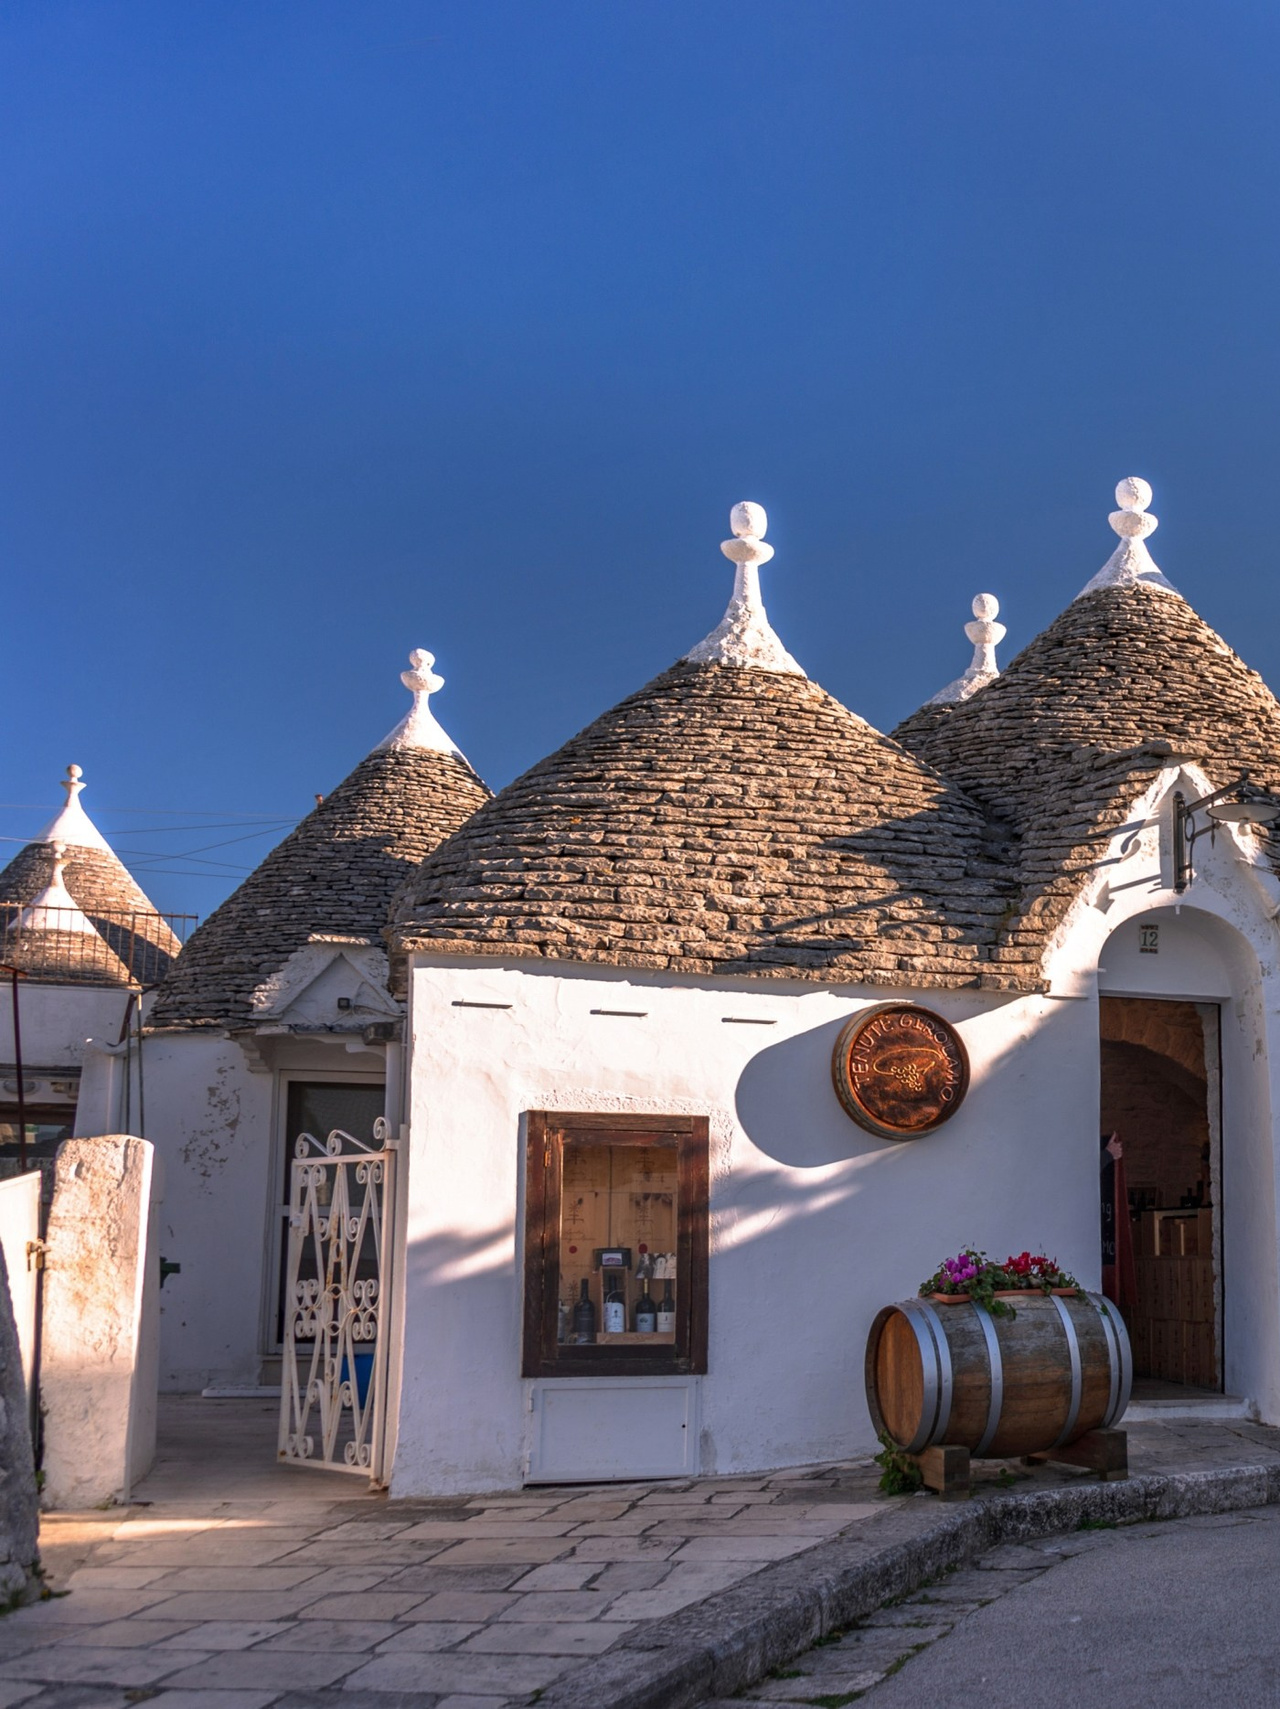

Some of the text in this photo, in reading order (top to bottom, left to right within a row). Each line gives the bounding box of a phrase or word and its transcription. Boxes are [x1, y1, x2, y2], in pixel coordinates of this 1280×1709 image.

[1141, 931, 1158, 947] 12
[852, 1013, 960, 1102] TENUTE GIROLAMO
